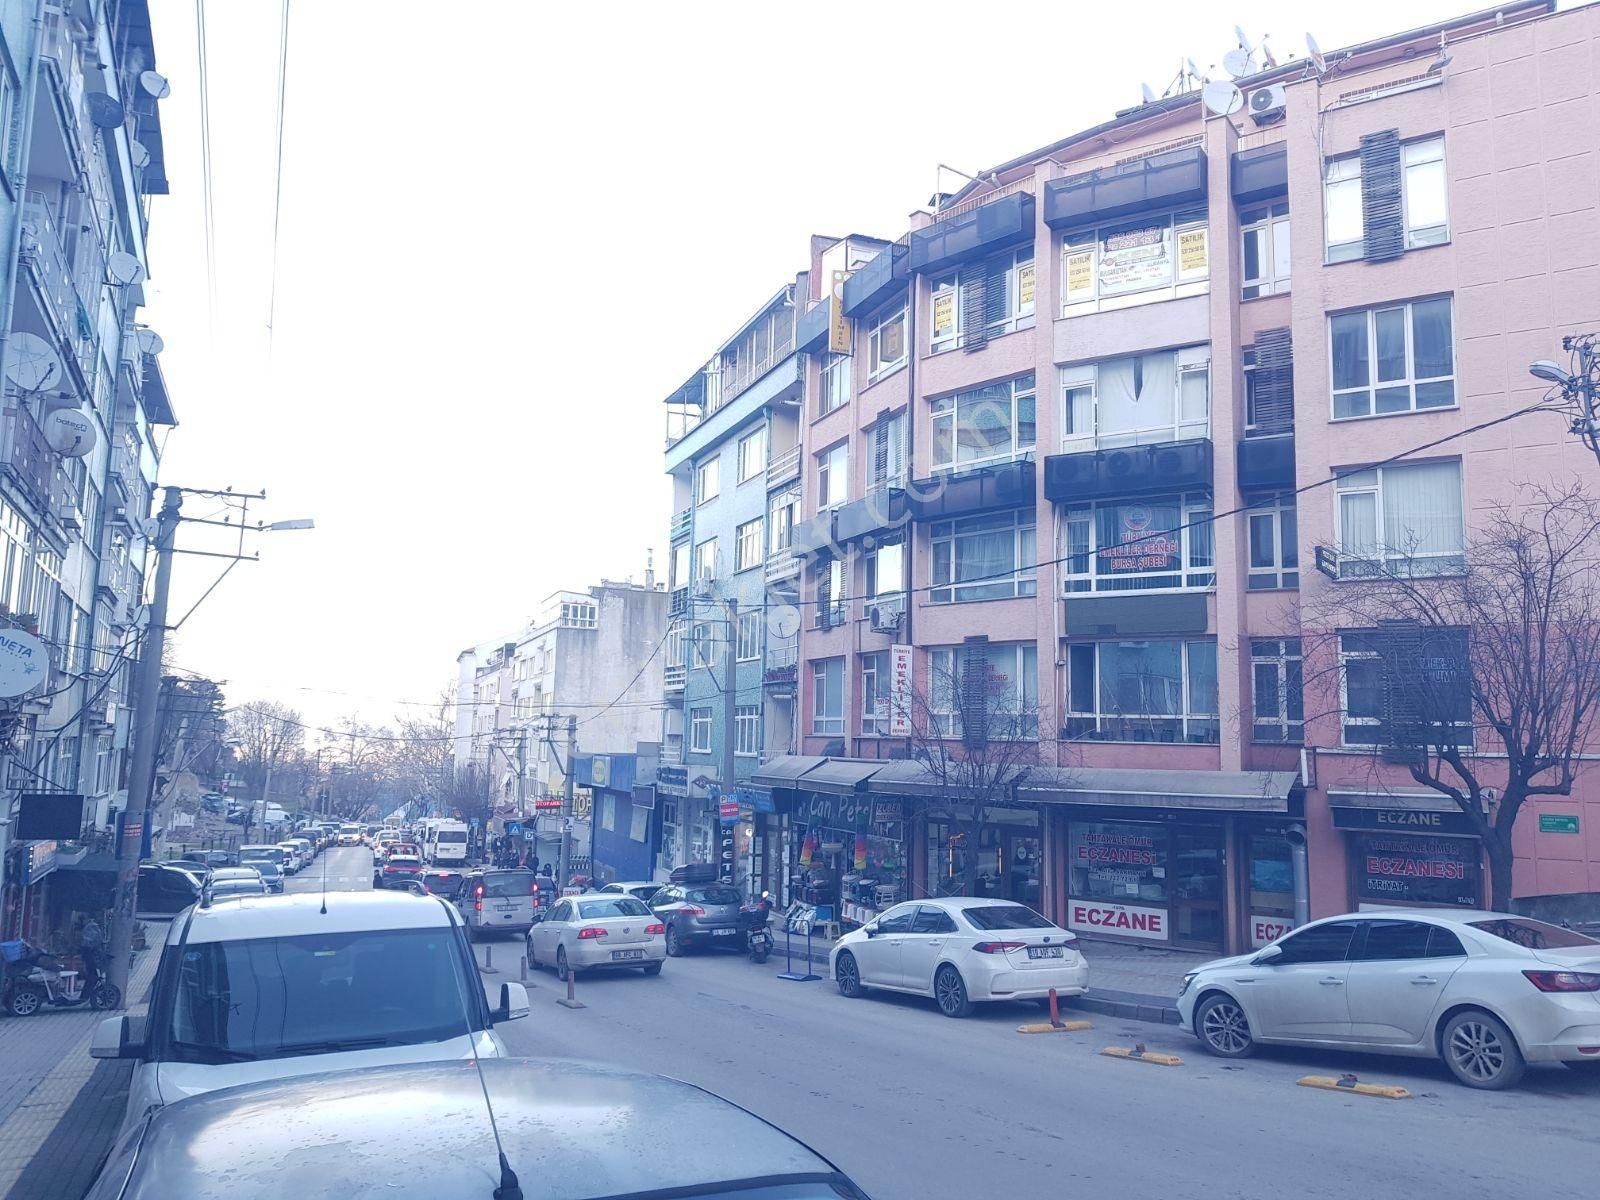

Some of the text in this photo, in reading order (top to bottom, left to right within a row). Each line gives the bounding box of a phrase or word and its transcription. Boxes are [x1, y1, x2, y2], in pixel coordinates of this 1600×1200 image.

[1111, 559, 1137, 569] BURSA
[1377, 811, 1441, 826] ECZANE
[1074, 902, 1162, 932] ECZANE
